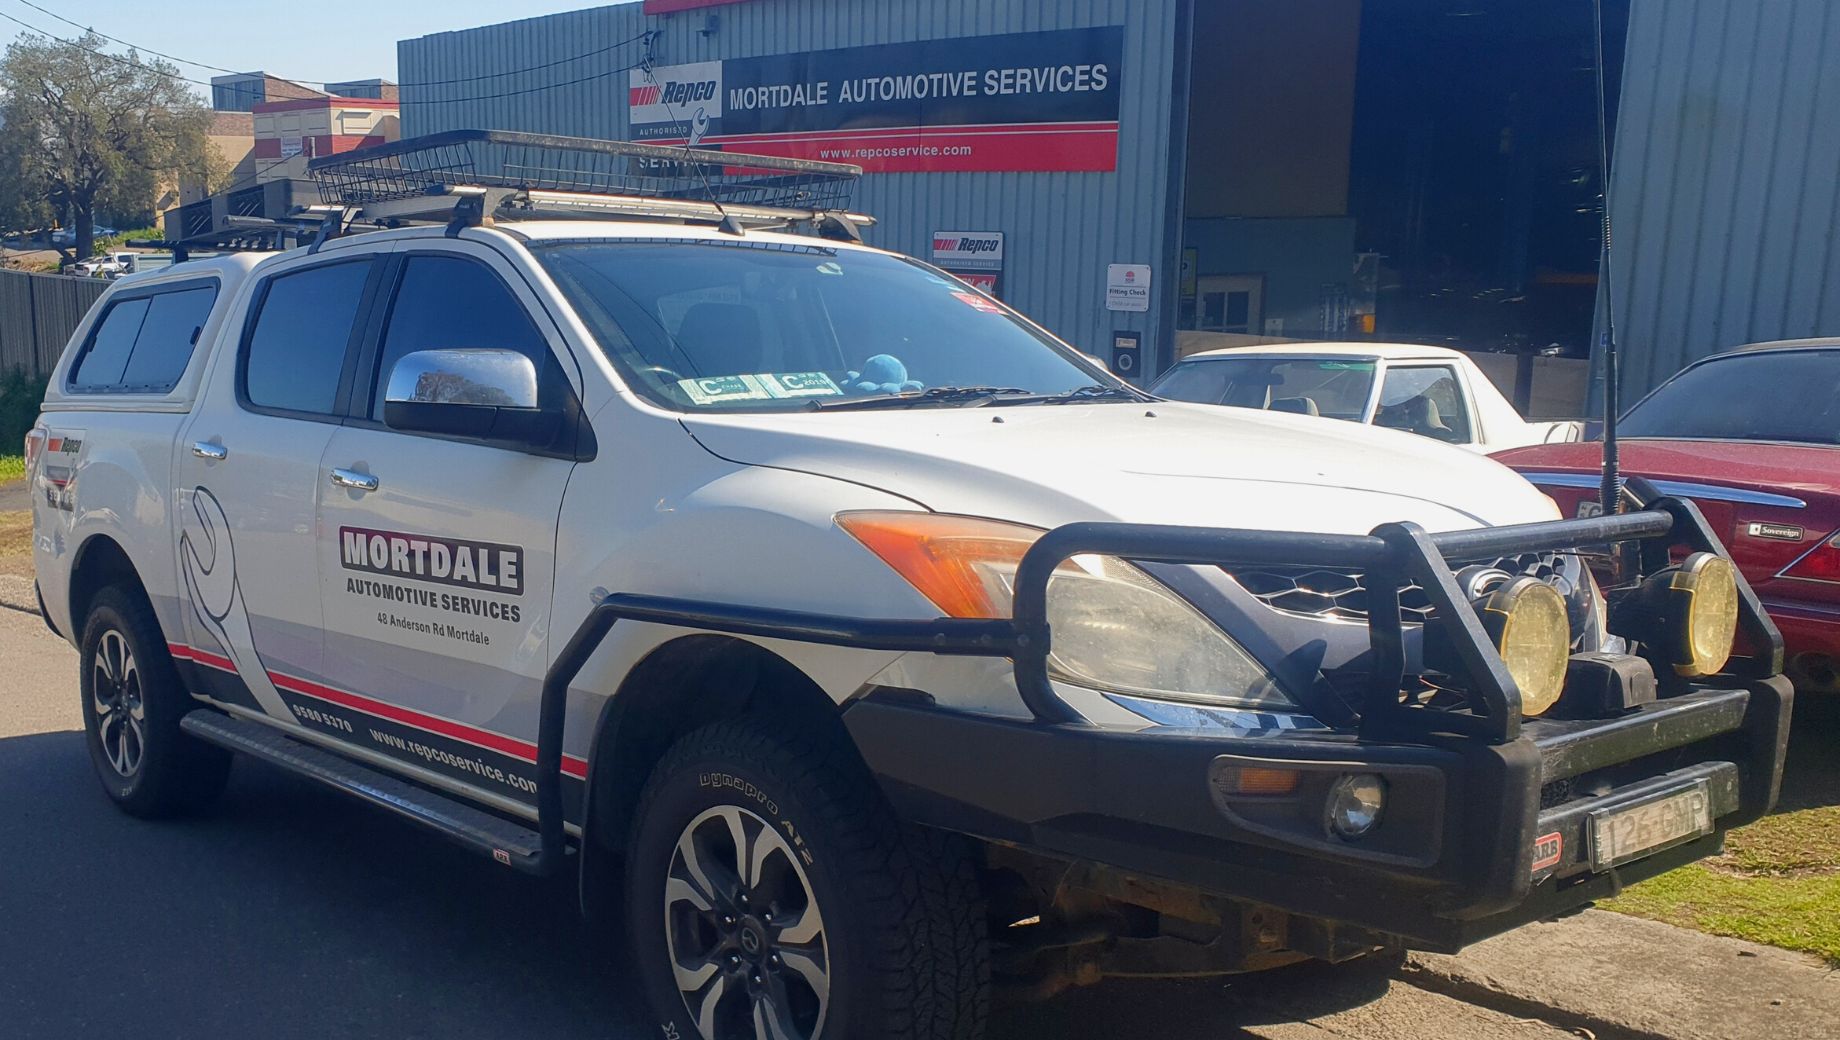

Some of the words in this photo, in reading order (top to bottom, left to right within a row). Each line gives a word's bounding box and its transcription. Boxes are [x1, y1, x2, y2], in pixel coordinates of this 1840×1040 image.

[661, 80, 716, 107] Repco
[730, 82, 828, 110] MORTDALE
[838, 72, 977, 103] AUTOMOTIVE
[984, 64, 1108, 95] SERVICES
[820, 145, 971, 159] www.repcoservice.com
[958, 237, 999, 254] Repco
[1109, 288, 1128, 297] Fitting
[60, 436, 82, 456] Repco
[1761, 526, 1800, 538] Sovereign
[343, 531, 518, 589] MORTDALE
[347, 577, 438, 608] AUTOMOTIVE
[441, 593, 521, 623] SERVICES
[377, 612, 388, 625] 48
[390, 615, 431, 634] Anderson
[433, 623, 445, 637] Rd
[447, 625, 490, 645] Mortdale
